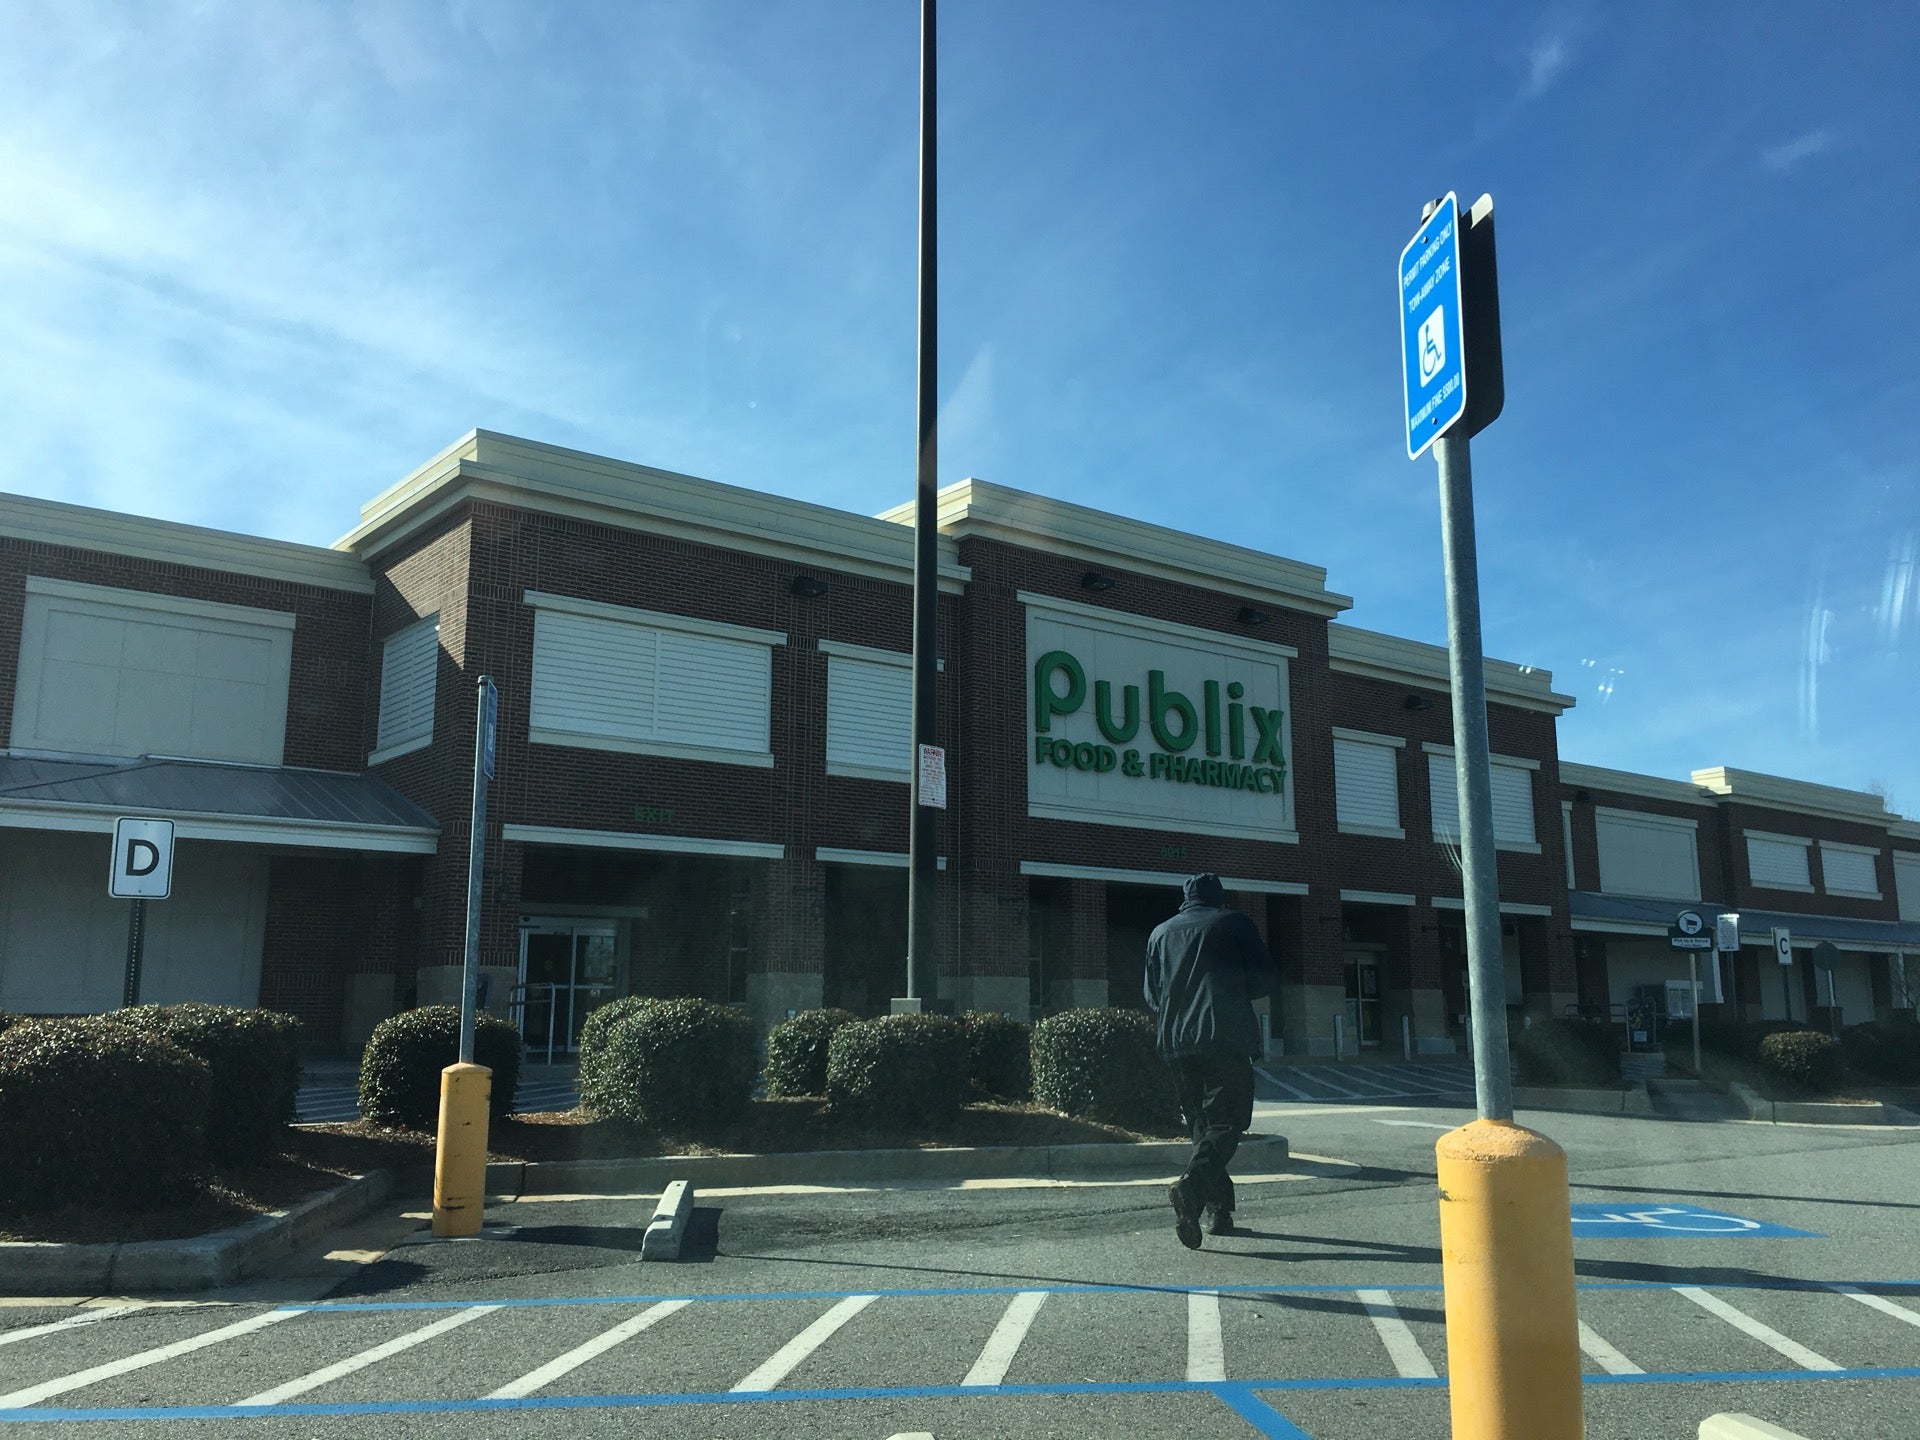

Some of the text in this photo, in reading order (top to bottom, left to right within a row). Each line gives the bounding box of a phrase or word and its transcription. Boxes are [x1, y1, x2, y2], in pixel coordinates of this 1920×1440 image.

[1404, 219, 1452, 290] PERMIT PARKING ONLY
[1435, 256, 1450, 284] ZONE
[1035, 650, 1285, 766] Publix
[1035, 736, 1286, 794] FOOD & PHARMACY
[126, 838, 160, 876] D
[1780, 937, 1789, 955] C
